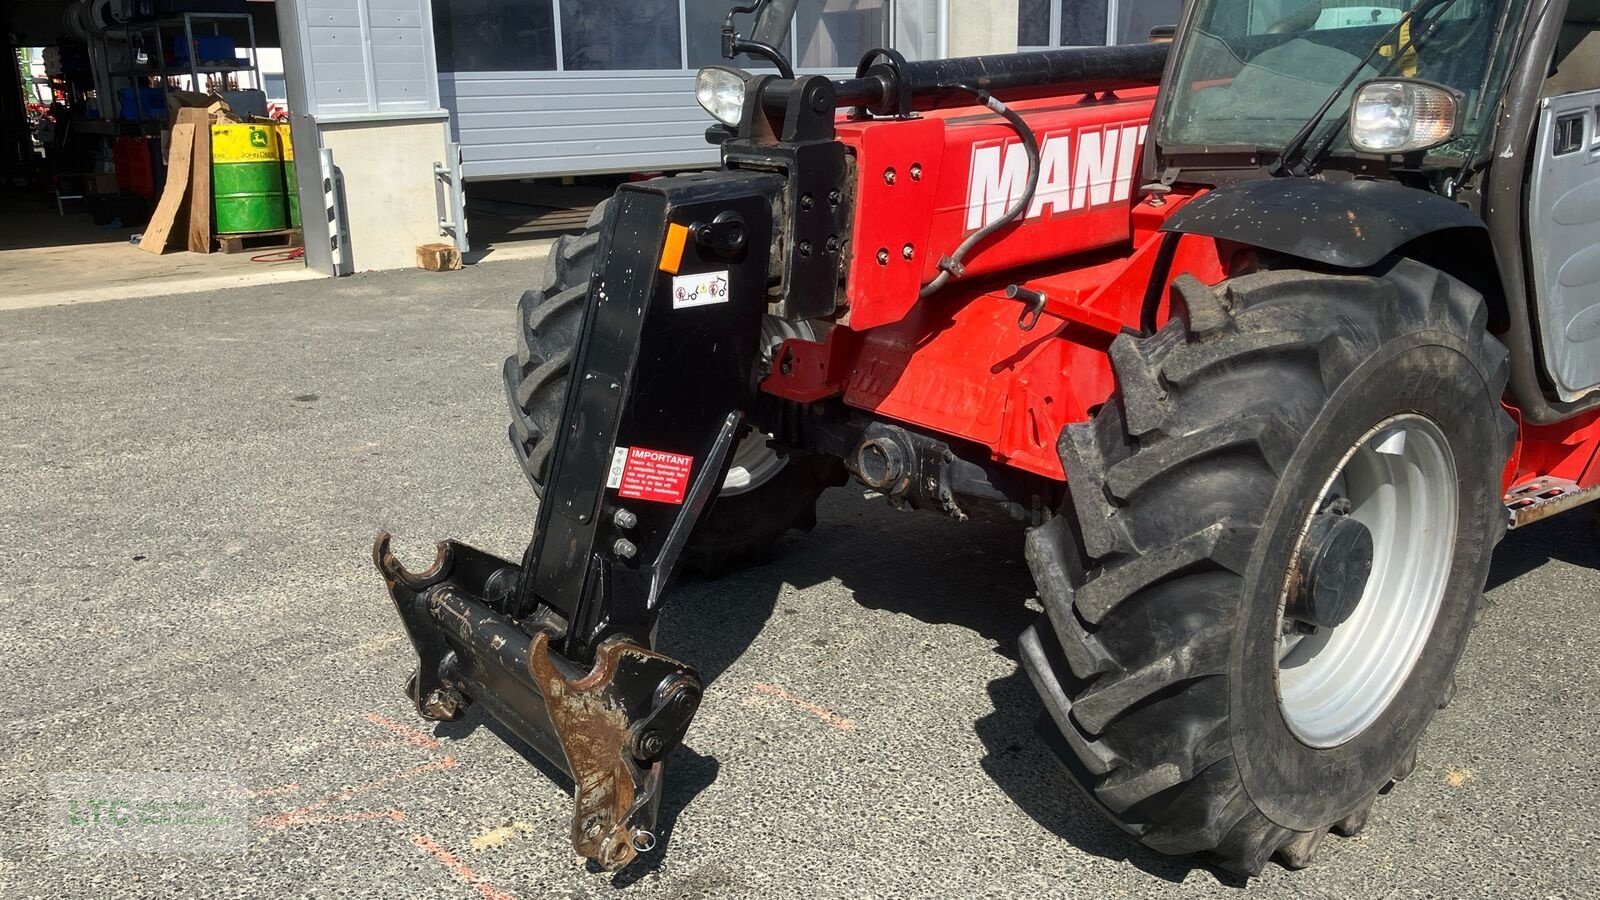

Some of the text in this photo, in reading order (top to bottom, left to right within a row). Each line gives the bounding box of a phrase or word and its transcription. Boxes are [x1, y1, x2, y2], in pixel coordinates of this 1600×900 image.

[632, 450, 690, 465] IMPORTANT
[656, 463, 680, 471] attachments
[657, 468, 674, 476] hydraulic
